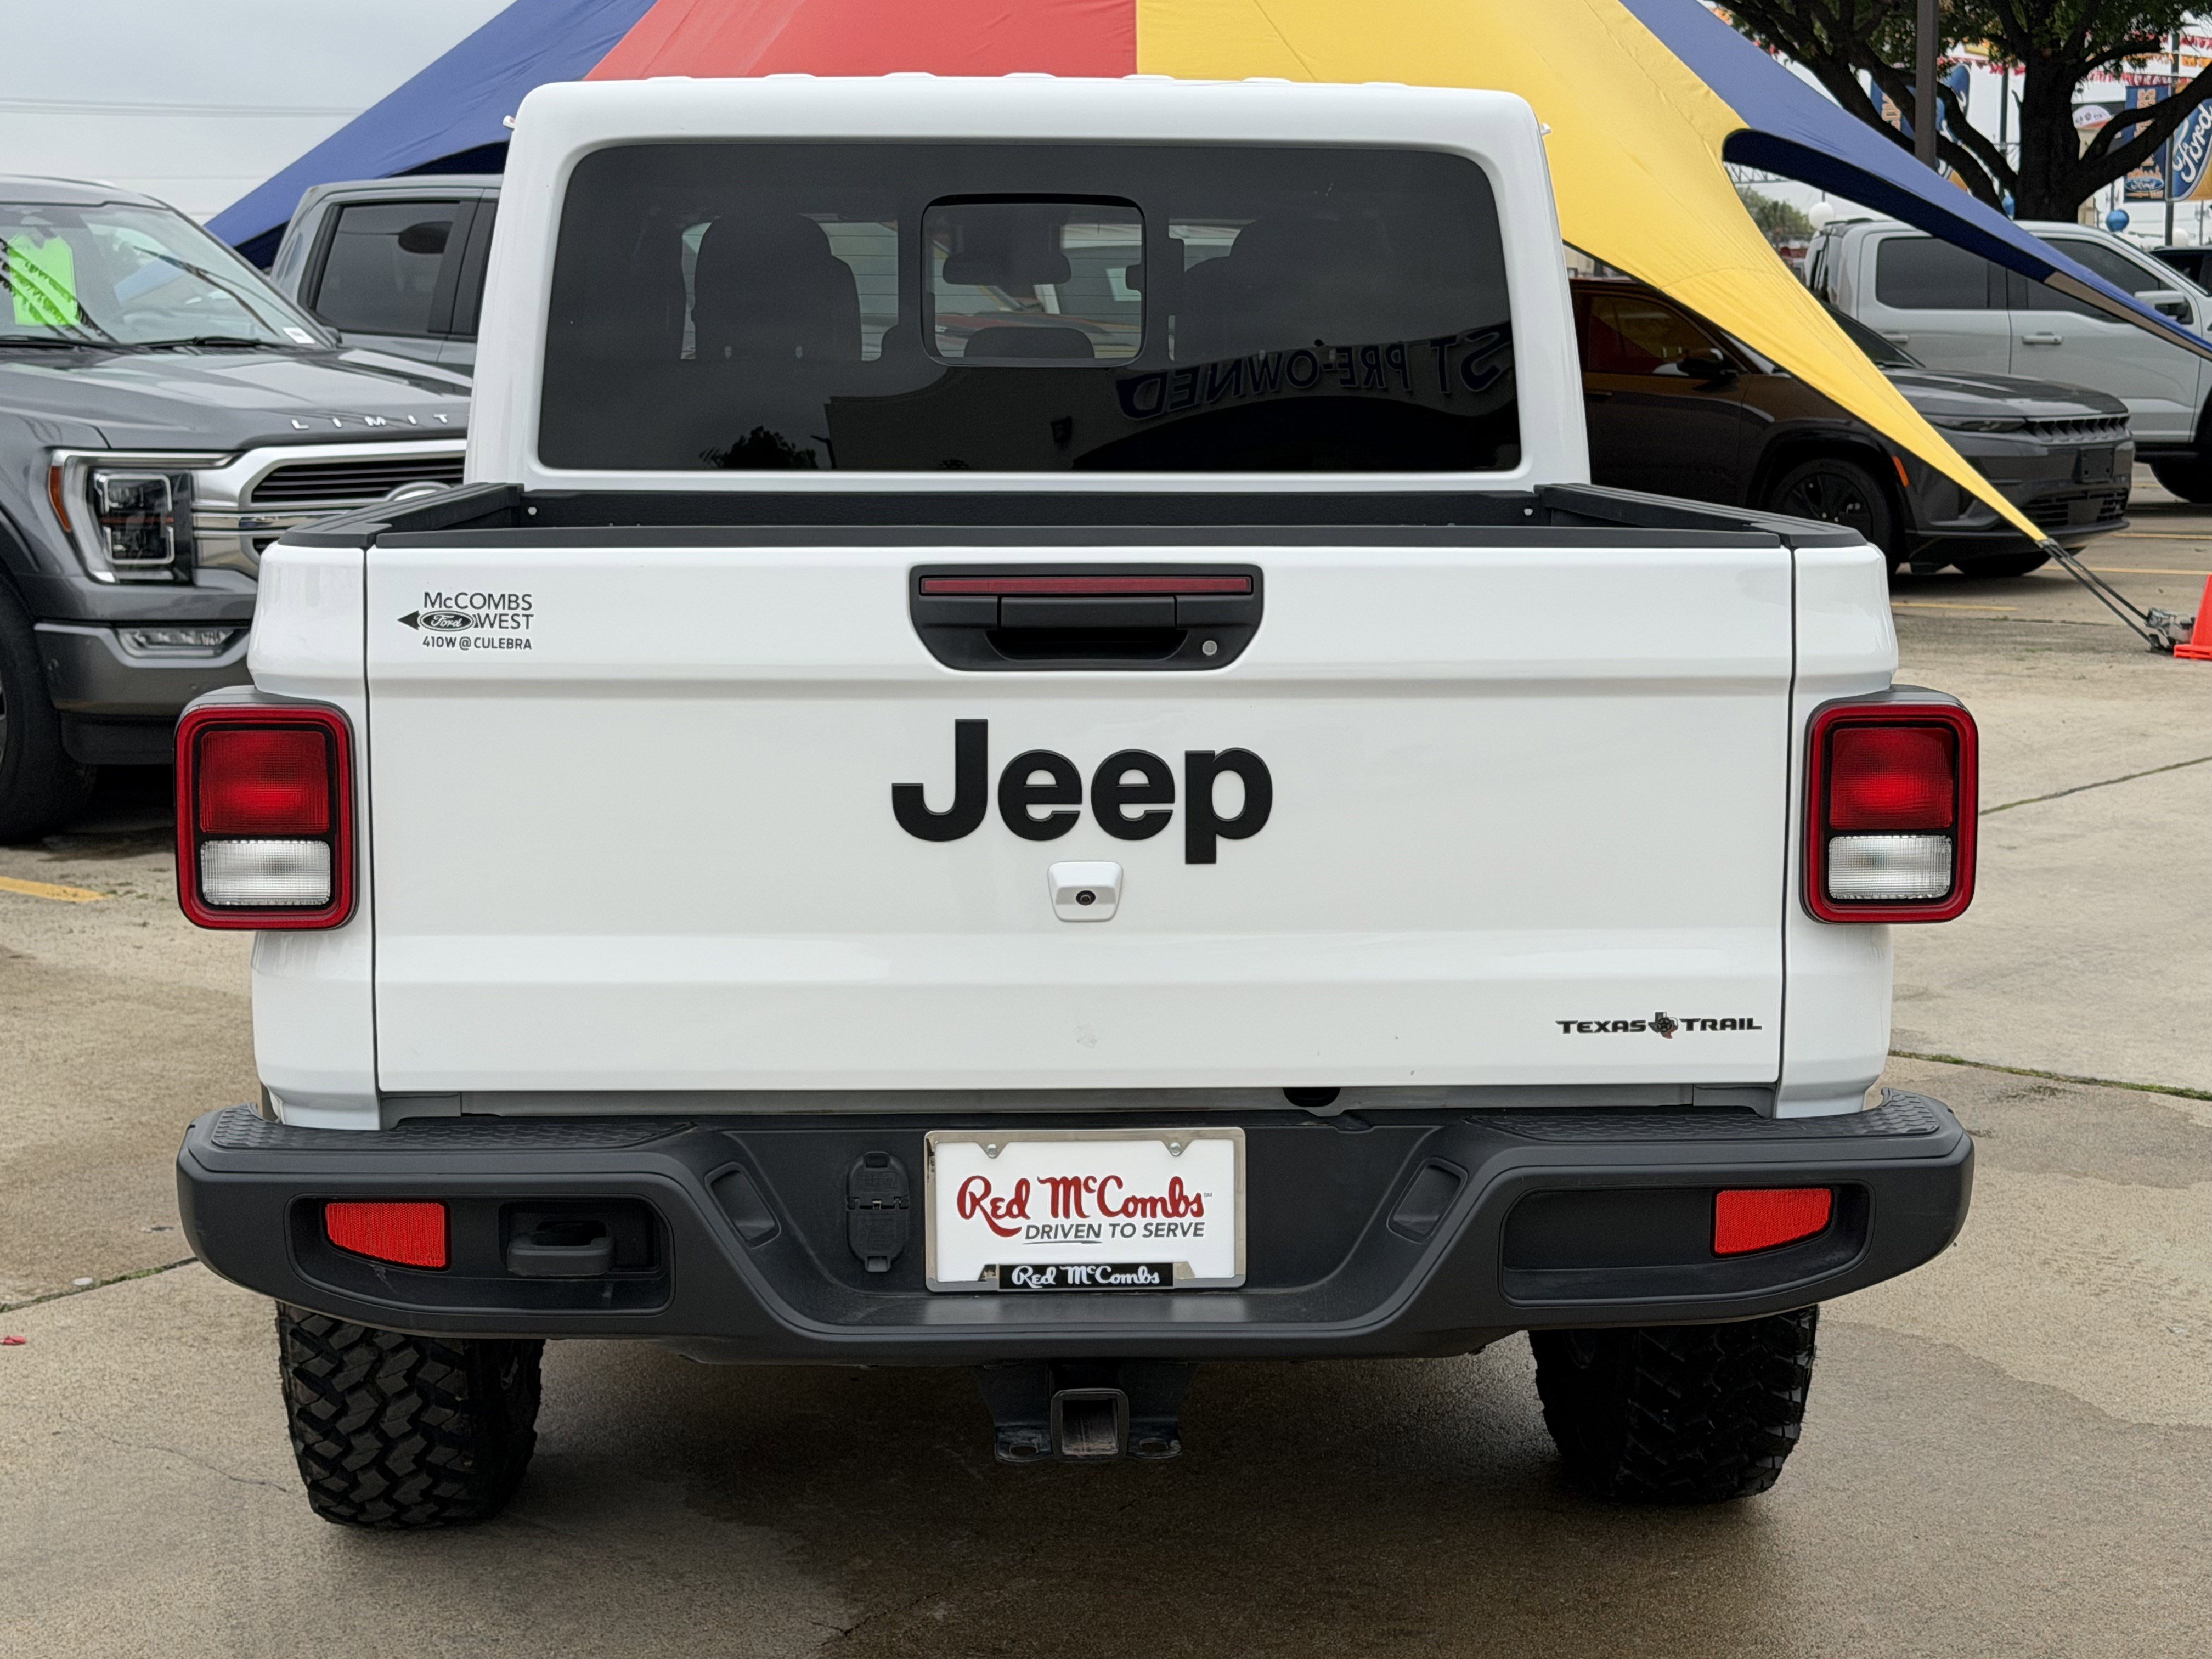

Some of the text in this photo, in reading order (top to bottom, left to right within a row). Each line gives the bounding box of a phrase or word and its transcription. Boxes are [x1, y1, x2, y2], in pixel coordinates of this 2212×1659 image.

[424, 591, 532, 611] McCOMBS
[431, 613, 534, 629] Ford WEST
[473, 637, 532, 650] CULEBRA
[891, 719, 1273, 864] Jeep
[1555, 1017, 1762, 1034] TEXAS TRAIL
[957, 1175, 1031, 1238] Red
[1037, 1175, 1204, 1220] McCombs
[1025, 1222, 1205, 1240] DRIVEN TO SERVE
[1011, 1265, 1160, 1288] Red McCombs
